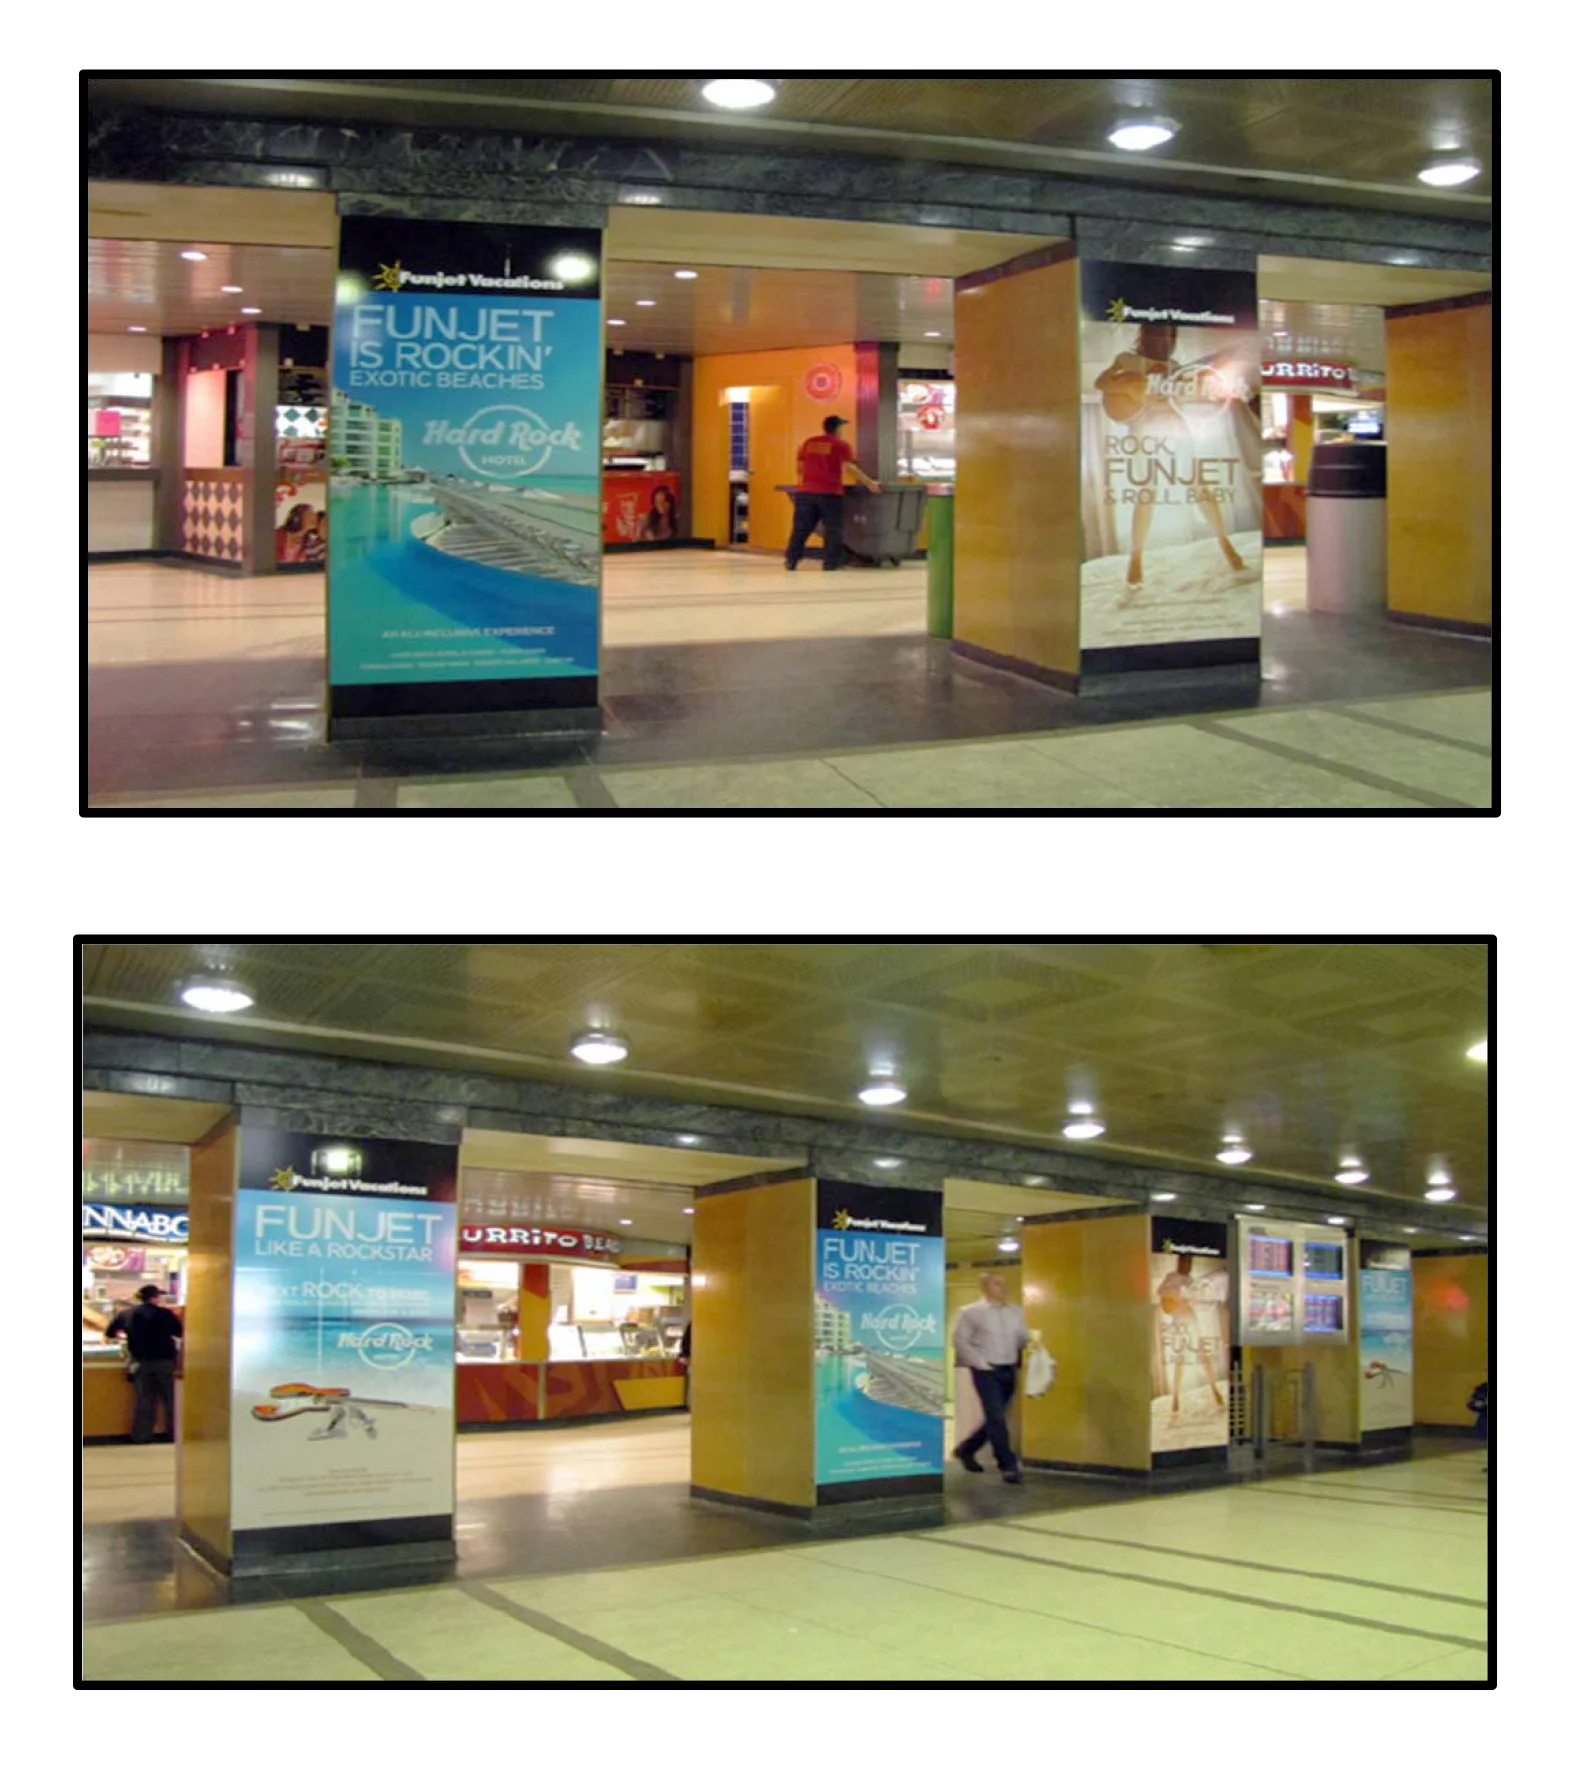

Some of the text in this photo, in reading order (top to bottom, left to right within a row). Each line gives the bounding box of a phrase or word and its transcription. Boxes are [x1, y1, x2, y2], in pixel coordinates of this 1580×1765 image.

[400, 271, 565, 291] Funjet Vacations
[352, 304, 554, 343] FUNJET
[350, 341, 553, 371] IS ROCKIN'
[350, 370, 546, 390] EXOTIC BEACHES
[422, 420, 582, 452] Hard Rock
[482, 454, 528, 466] HOTEL
[1103, 457, 1241, 487] FUNJET
[1186, 486, 1237, 504] BABY
[292, 1175, 428, 1196] Funjet Vacations
[254, 1204, 443, 1245] FUNJET
[255, 1239, 434, 1262] LIKE A ROCKSTAR
[824, 1238, 920, 1264] FUNJET
[825, 1263, 840, 1280] IS
[301, 1280, 363, 1299] ROCK
[337, 1331, 434, 1351] Hard Rock
